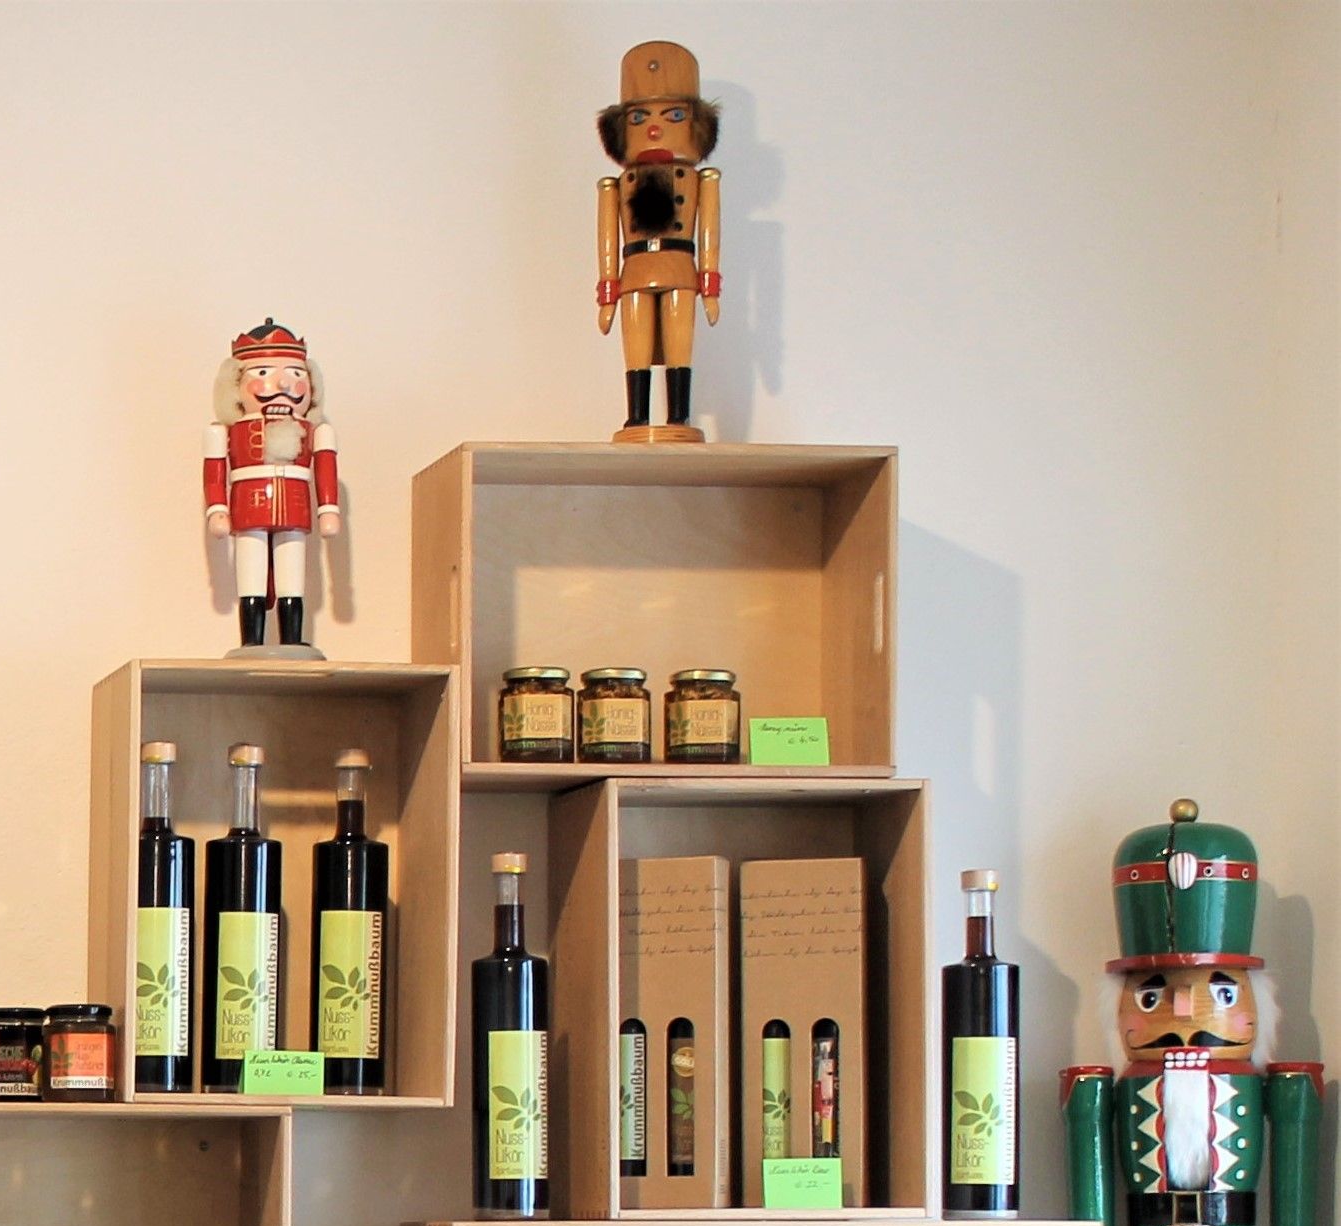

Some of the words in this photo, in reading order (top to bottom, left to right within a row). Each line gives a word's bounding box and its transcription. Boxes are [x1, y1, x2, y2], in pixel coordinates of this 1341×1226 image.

[178, 909, 189, 1054] Krummnußbaum
[322, 1025, 351, 1042] Likör
[366, 912, 382, 1057] Krummnußbaum
[630, 1035, 645, 1159] Krummnußbaum
